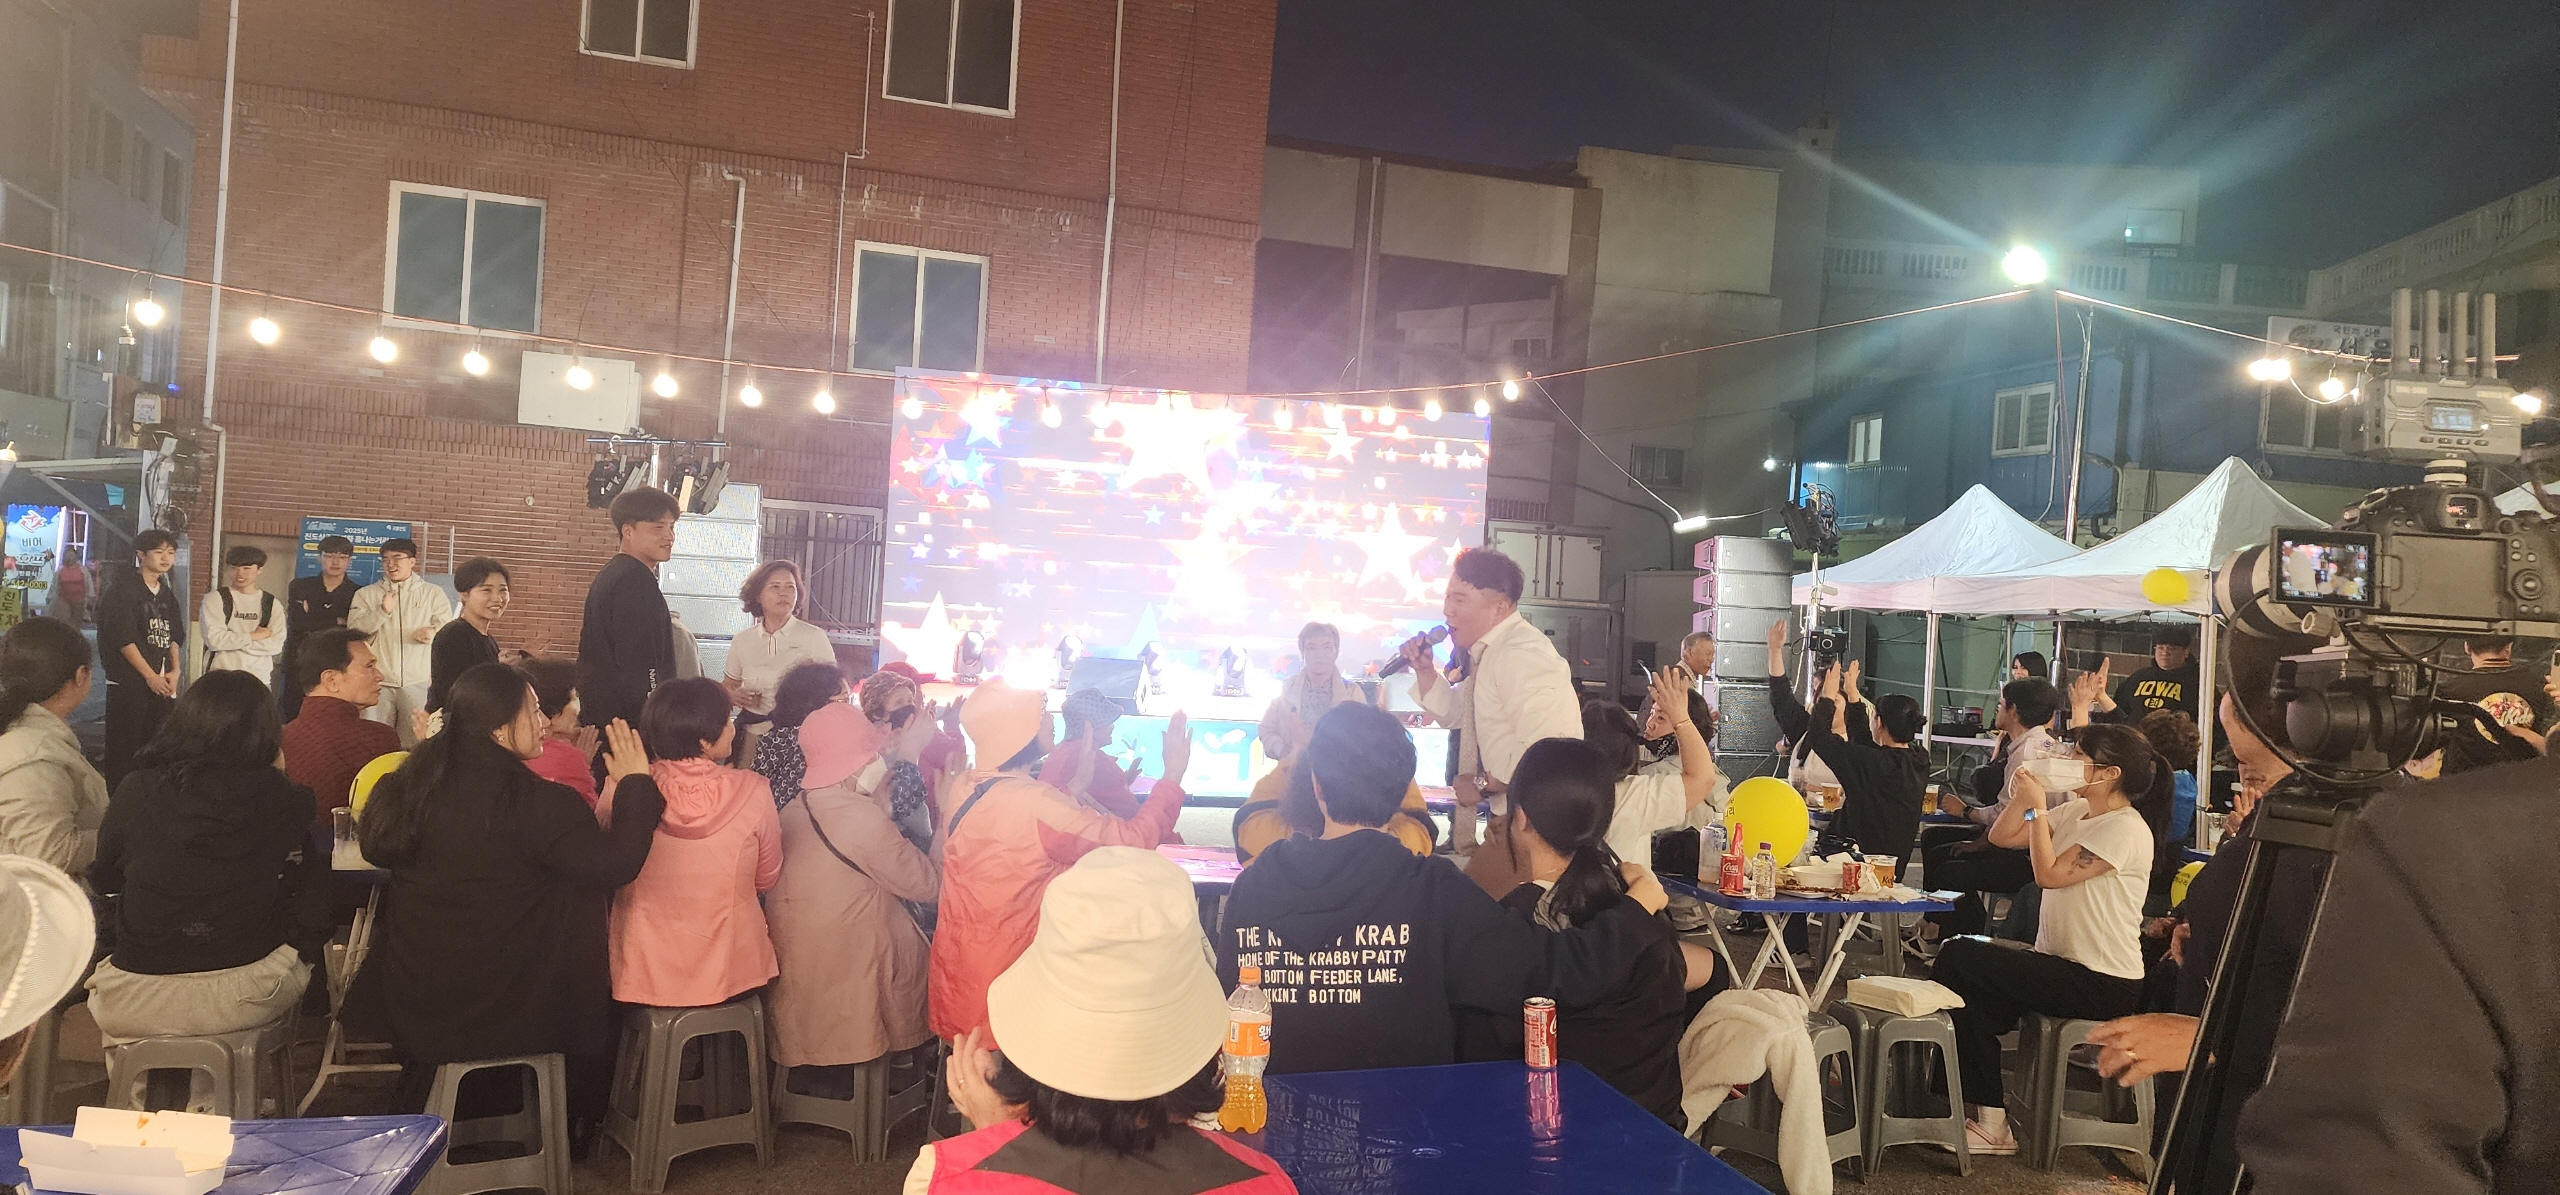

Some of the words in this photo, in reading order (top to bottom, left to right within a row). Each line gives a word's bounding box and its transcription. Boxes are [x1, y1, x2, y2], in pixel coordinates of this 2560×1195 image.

[344, 527, 367, 535] 2025년
[22, 537, 42, 546] 비어
[2133, 680, 2182, 702] IOWA
[1236, 926, 1261, 948] THE
[1355, 923, 1410, 946] KRAB
[1238, 951, 1263, 967] HOME
[1264, 951, 1281, 966] OF
[1284, 951, 1304, 966] THE
[1309, 951, 1358, 966] KRABBY
[1362, 949, 1407, 965] PATTY
[1264, 969, 1303, 984] BOTTOM
[1310, 969, 1362, 984] FEEDER
[1367, 968, 1403, 984] LANE,
[1309, 988, 1361, 1004] BOTTOM
